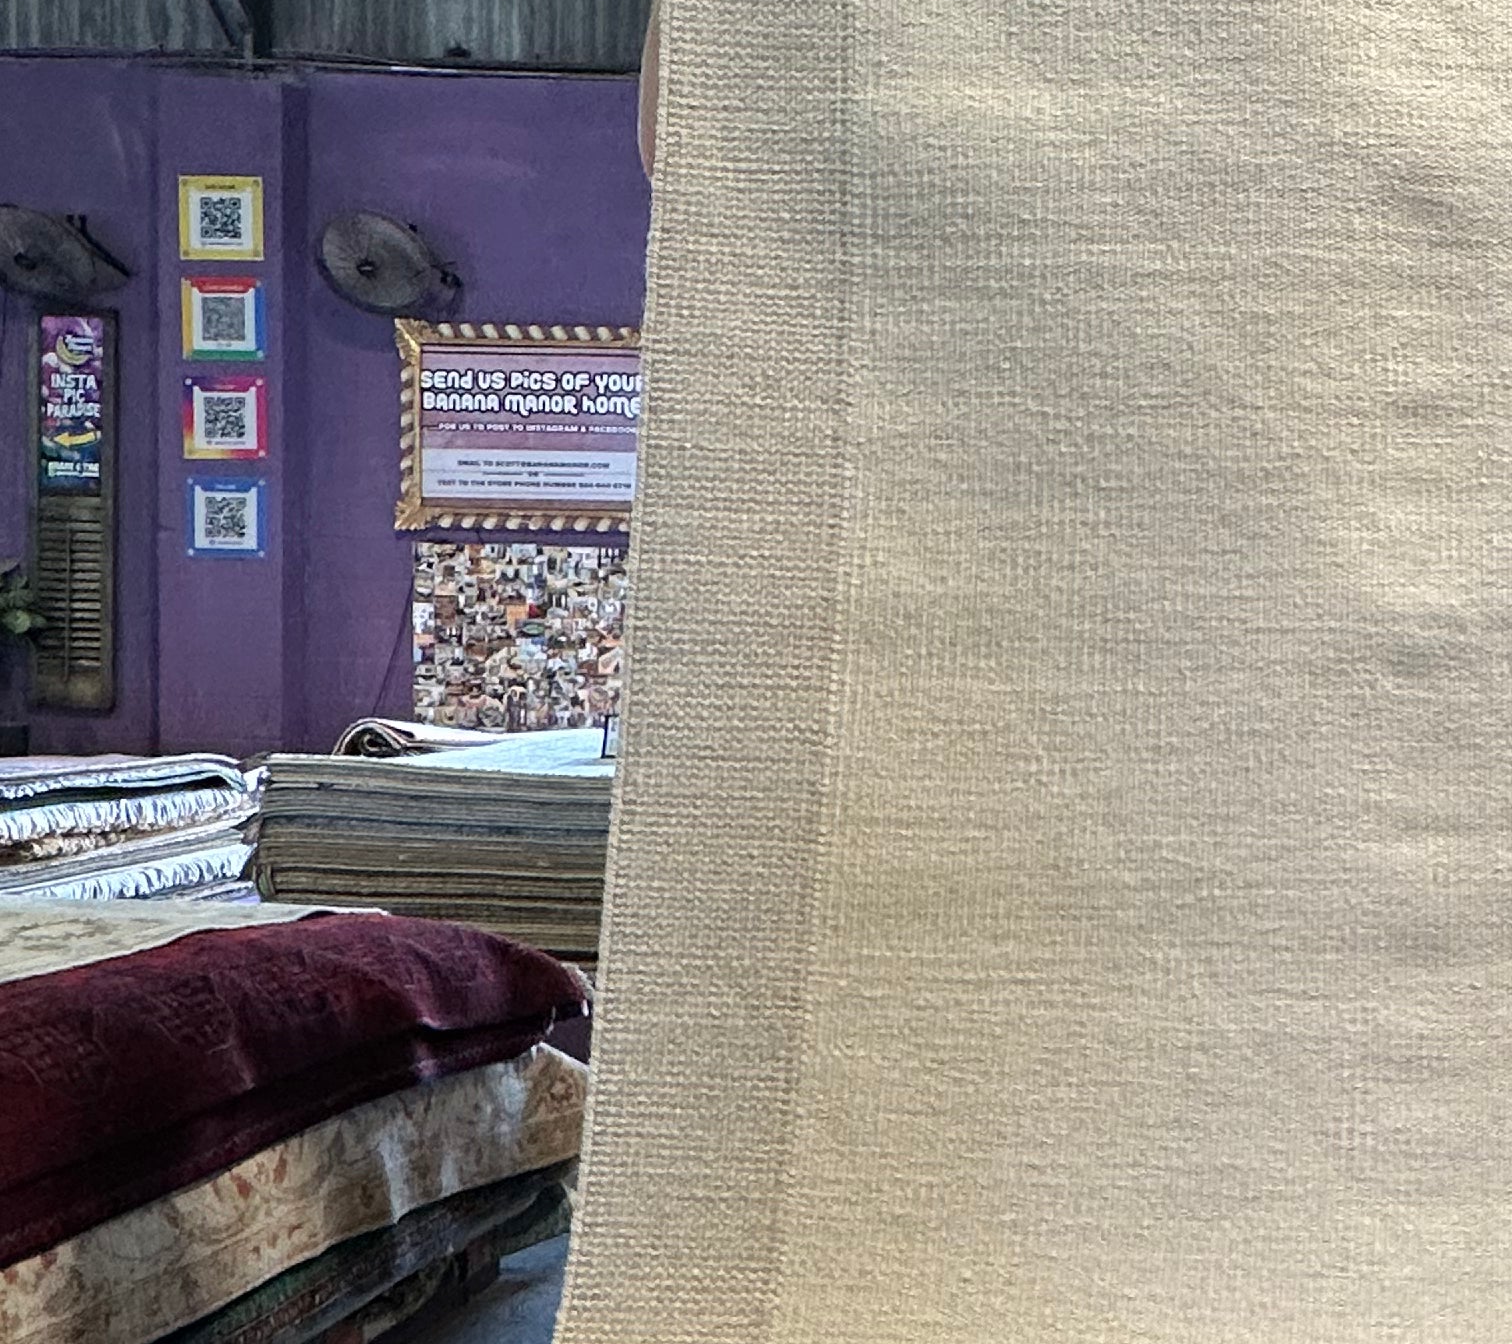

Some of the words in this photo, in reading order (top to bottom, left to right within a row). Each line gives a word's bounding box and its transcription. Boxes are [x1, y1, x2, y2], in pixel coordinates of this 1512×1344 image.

[50, 373, 98, 390] INSTA
[420, 369, 474, 390] SEND
[478, 372, 506, 390] US
[510, 371, 556, 391] PICS
[561, 373, 590, 391] OF
[63, 389, 86, 403] PIC
[421, 391, 500, 411] BANANA
[504, 394, 578, 417] MANOR
[46, 403, 101, 418] PARADISE
[513, 424, 524, 432] TO
